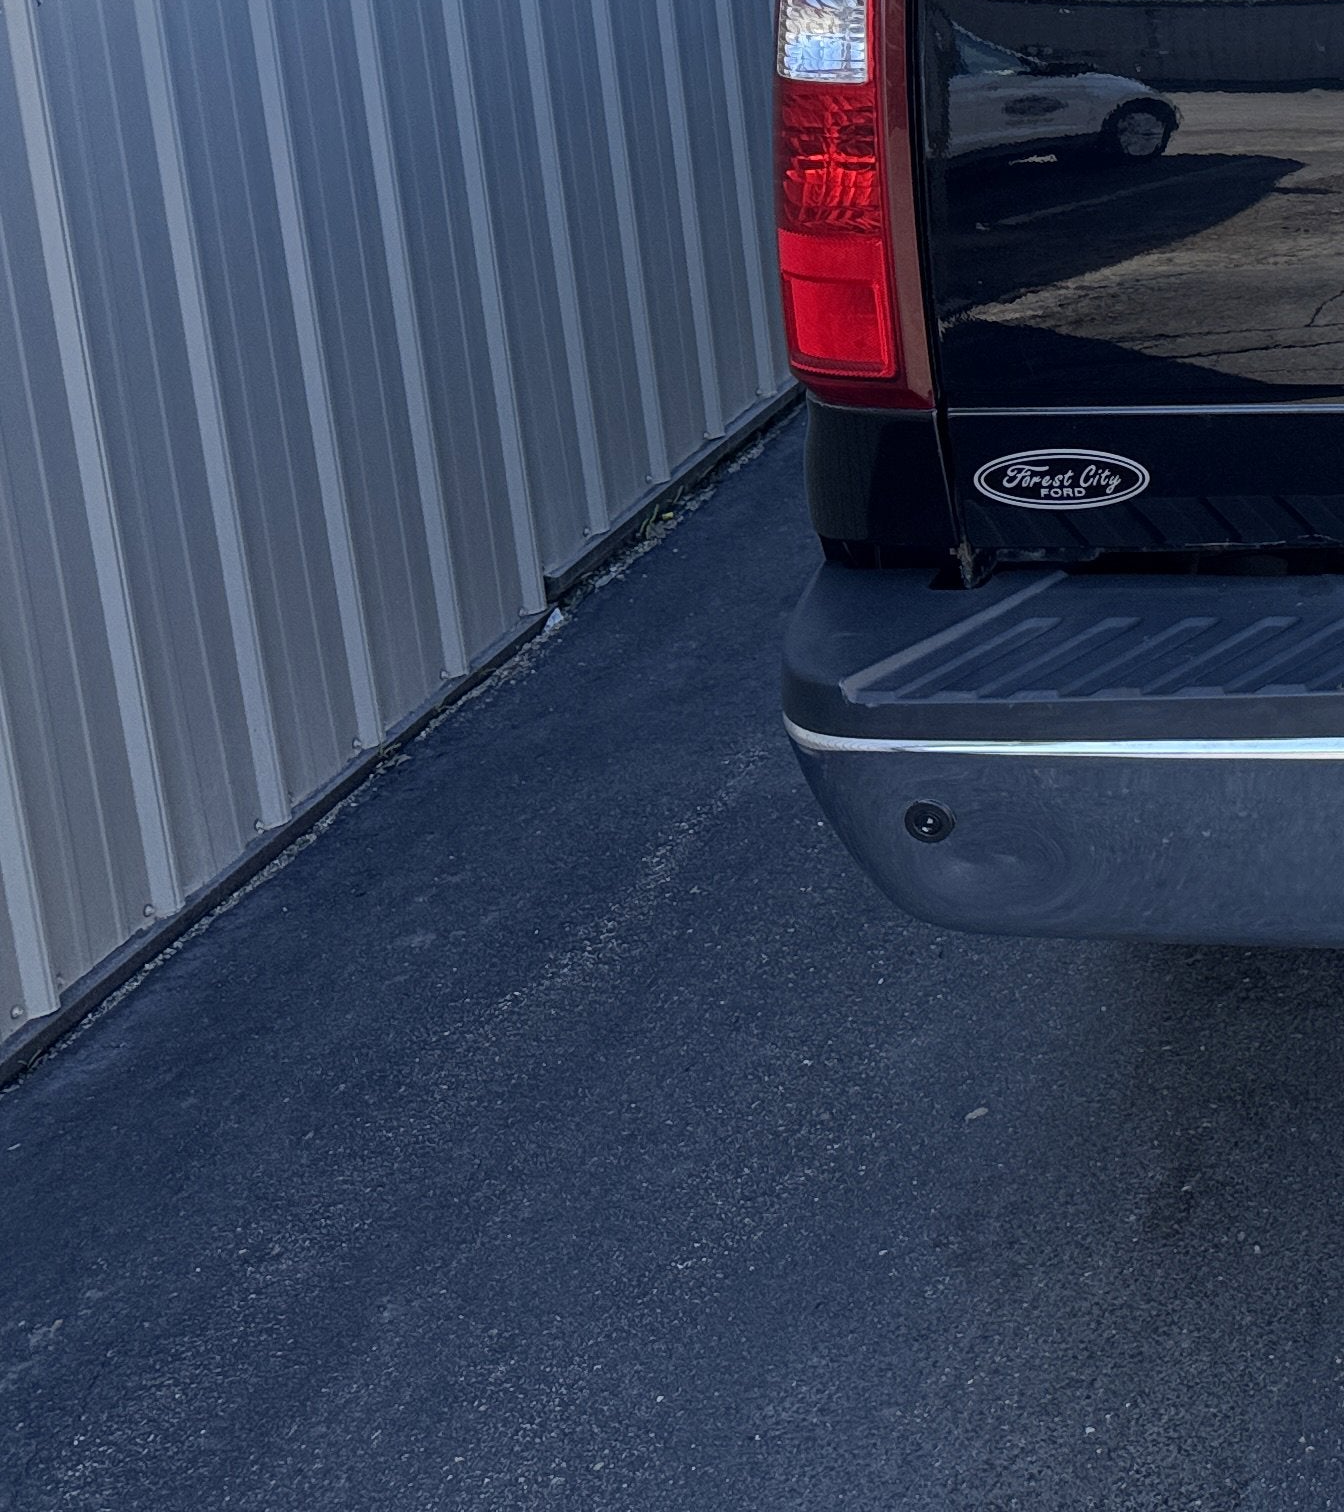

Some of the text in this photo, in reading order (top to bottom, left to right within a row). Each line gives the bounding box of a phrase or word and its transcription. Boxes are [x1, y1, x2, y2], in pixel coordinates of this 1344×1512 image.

[1002, 464, 1122, 494] Forest City
[1040, 488, 1086, 498] FORD
